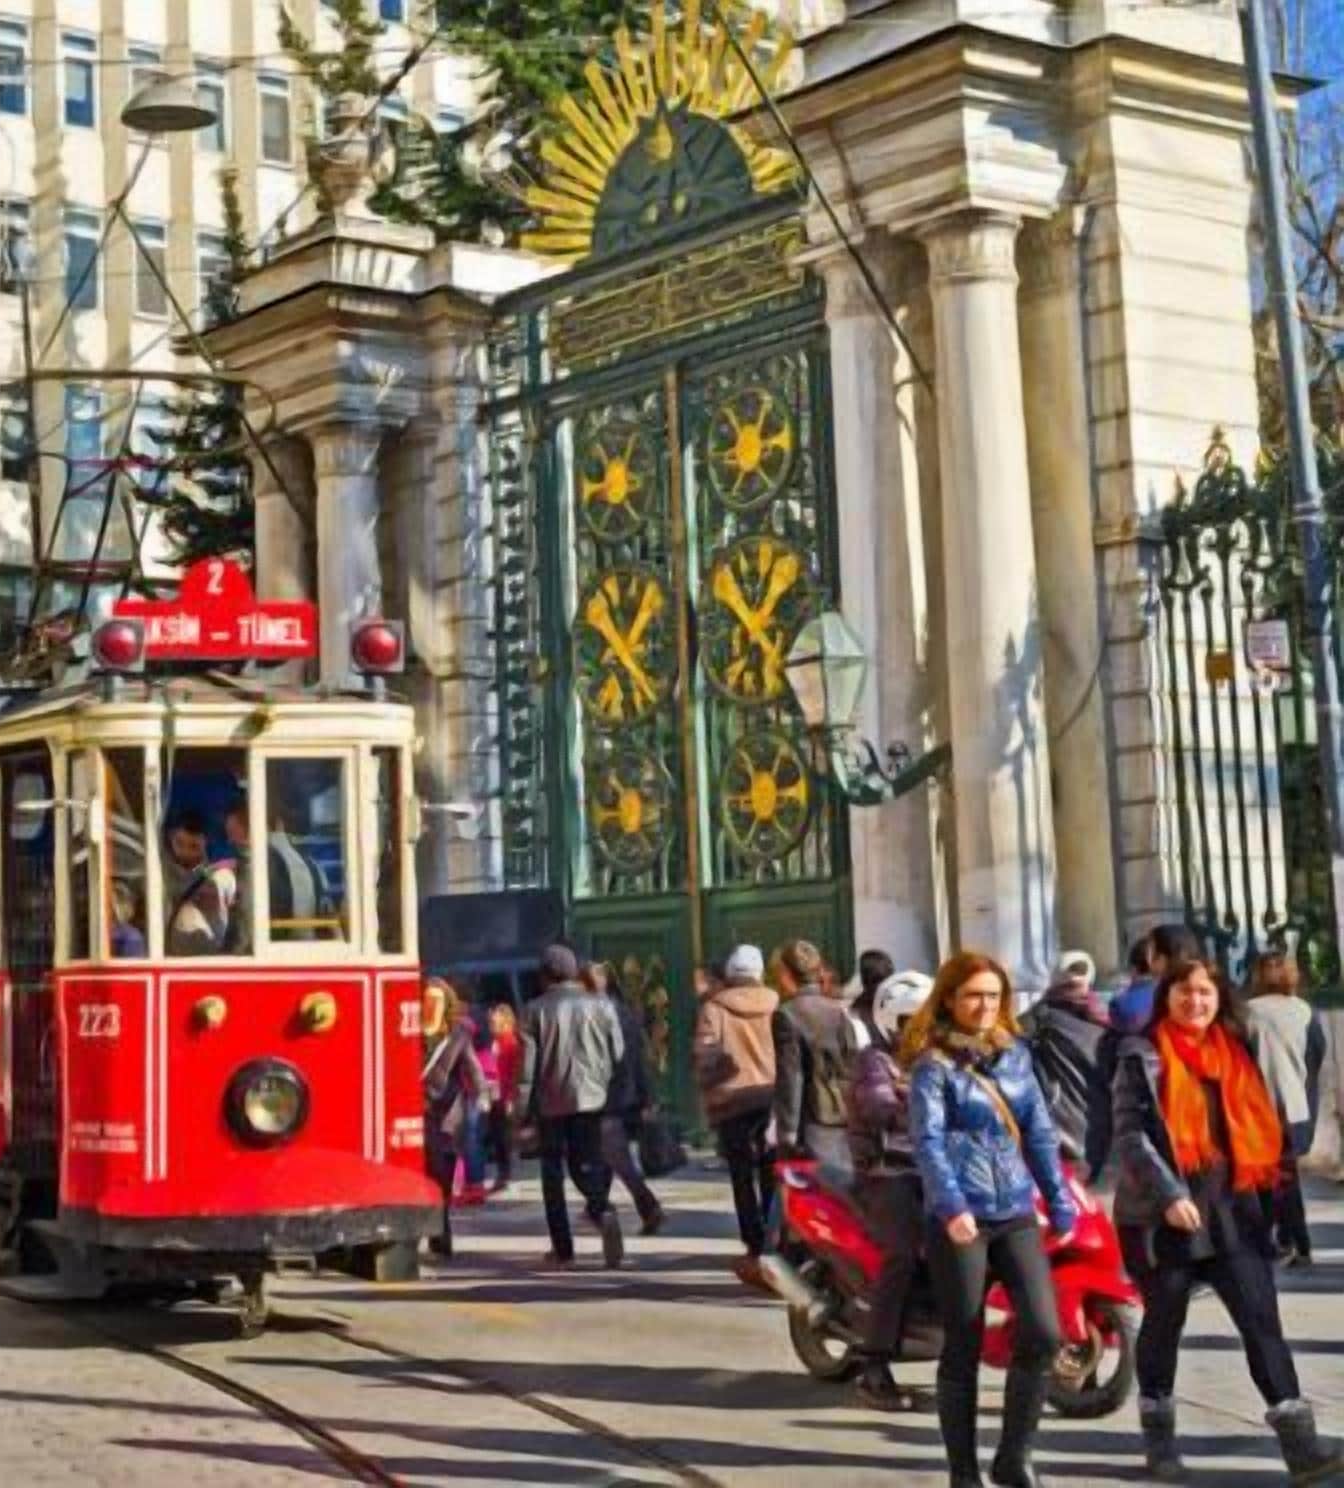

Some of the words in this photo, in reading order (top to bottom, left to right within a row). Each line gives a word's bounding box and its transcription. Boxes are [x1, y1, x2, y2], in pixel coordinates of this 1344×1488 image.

[207, 562, 224, 595] 2
[237, 611, 309, 647] TÜNEL
[79, 1003, 121, 1037] 223
